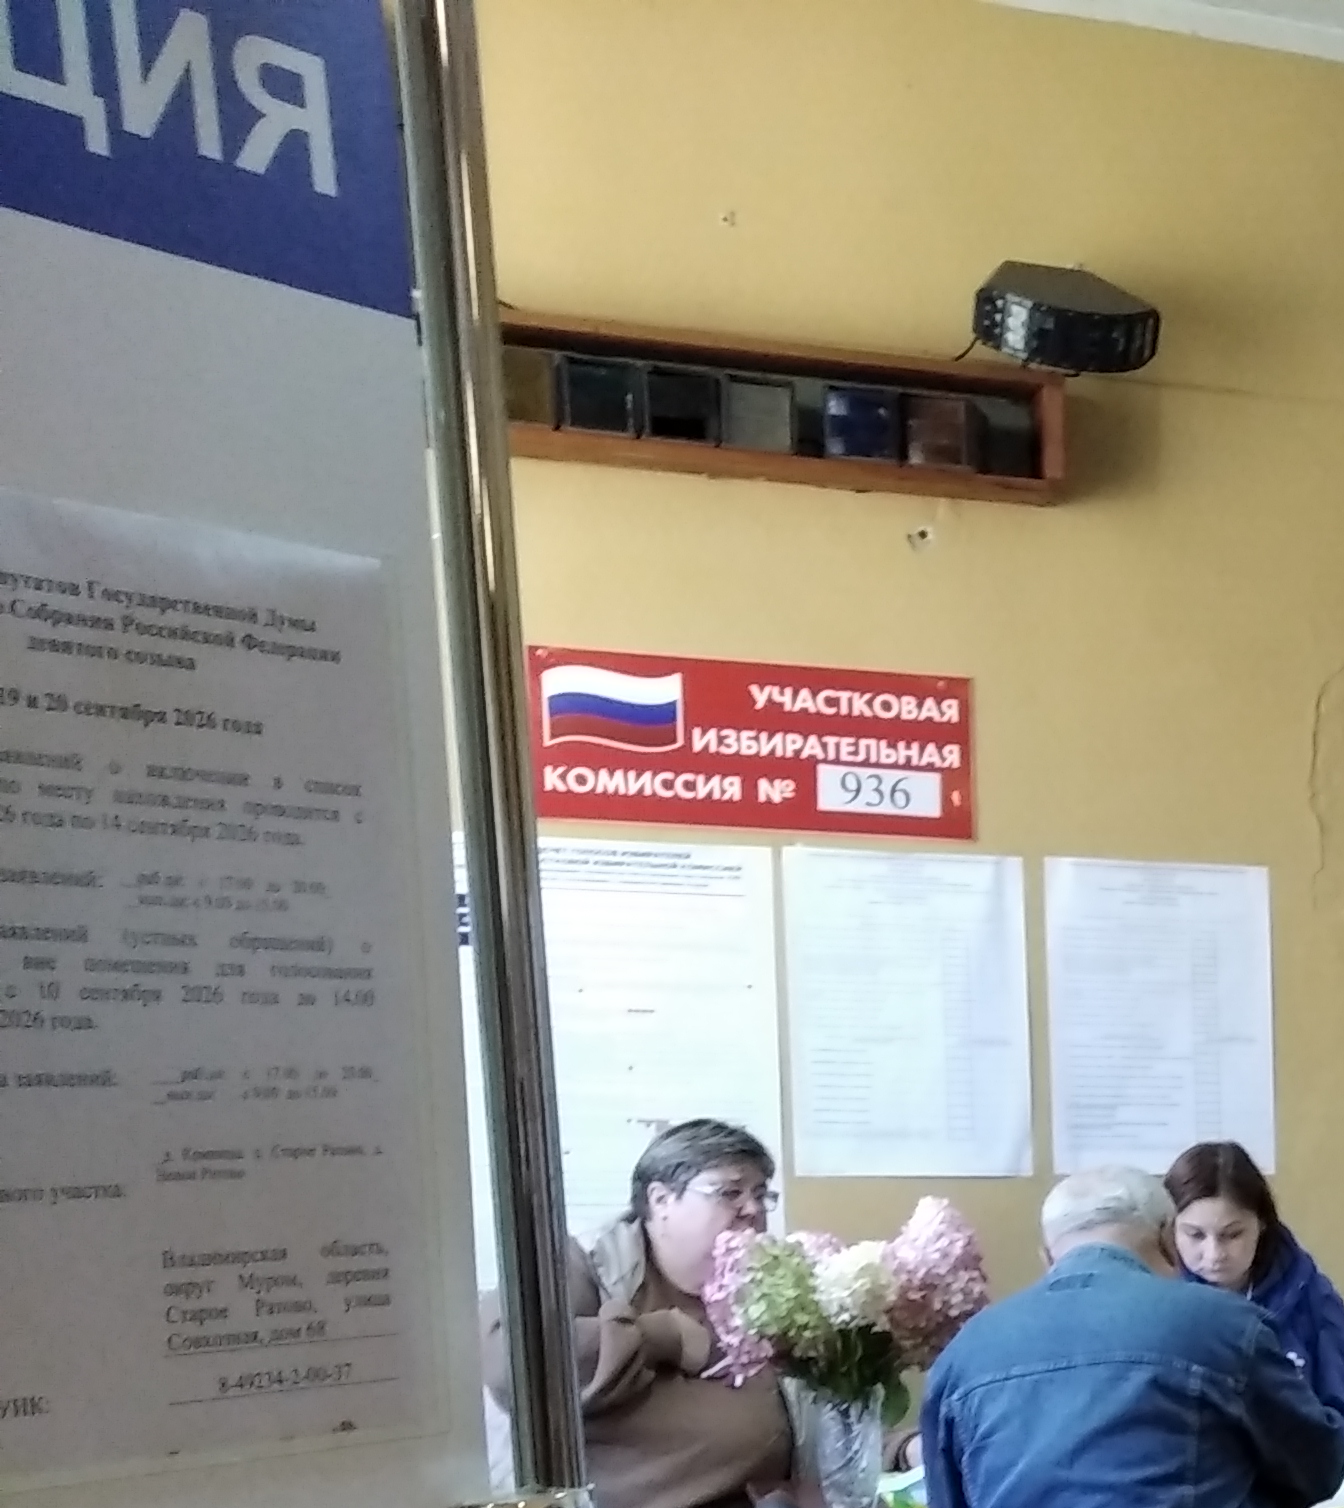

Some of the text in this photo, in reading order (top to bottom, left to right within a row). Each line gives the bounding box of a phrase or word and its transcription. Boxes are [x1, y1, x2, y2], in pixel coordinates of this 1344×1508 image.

[748, 683, 961, 725] УЧАСТКОВАЯ
[691, 726, 962, 769] ИЗБИРАТЕЛЬНАЯ
[543, 764, 913, 810] КОМИССИЯ № 936
[161, 1245, 288, 1271] Владимирская
